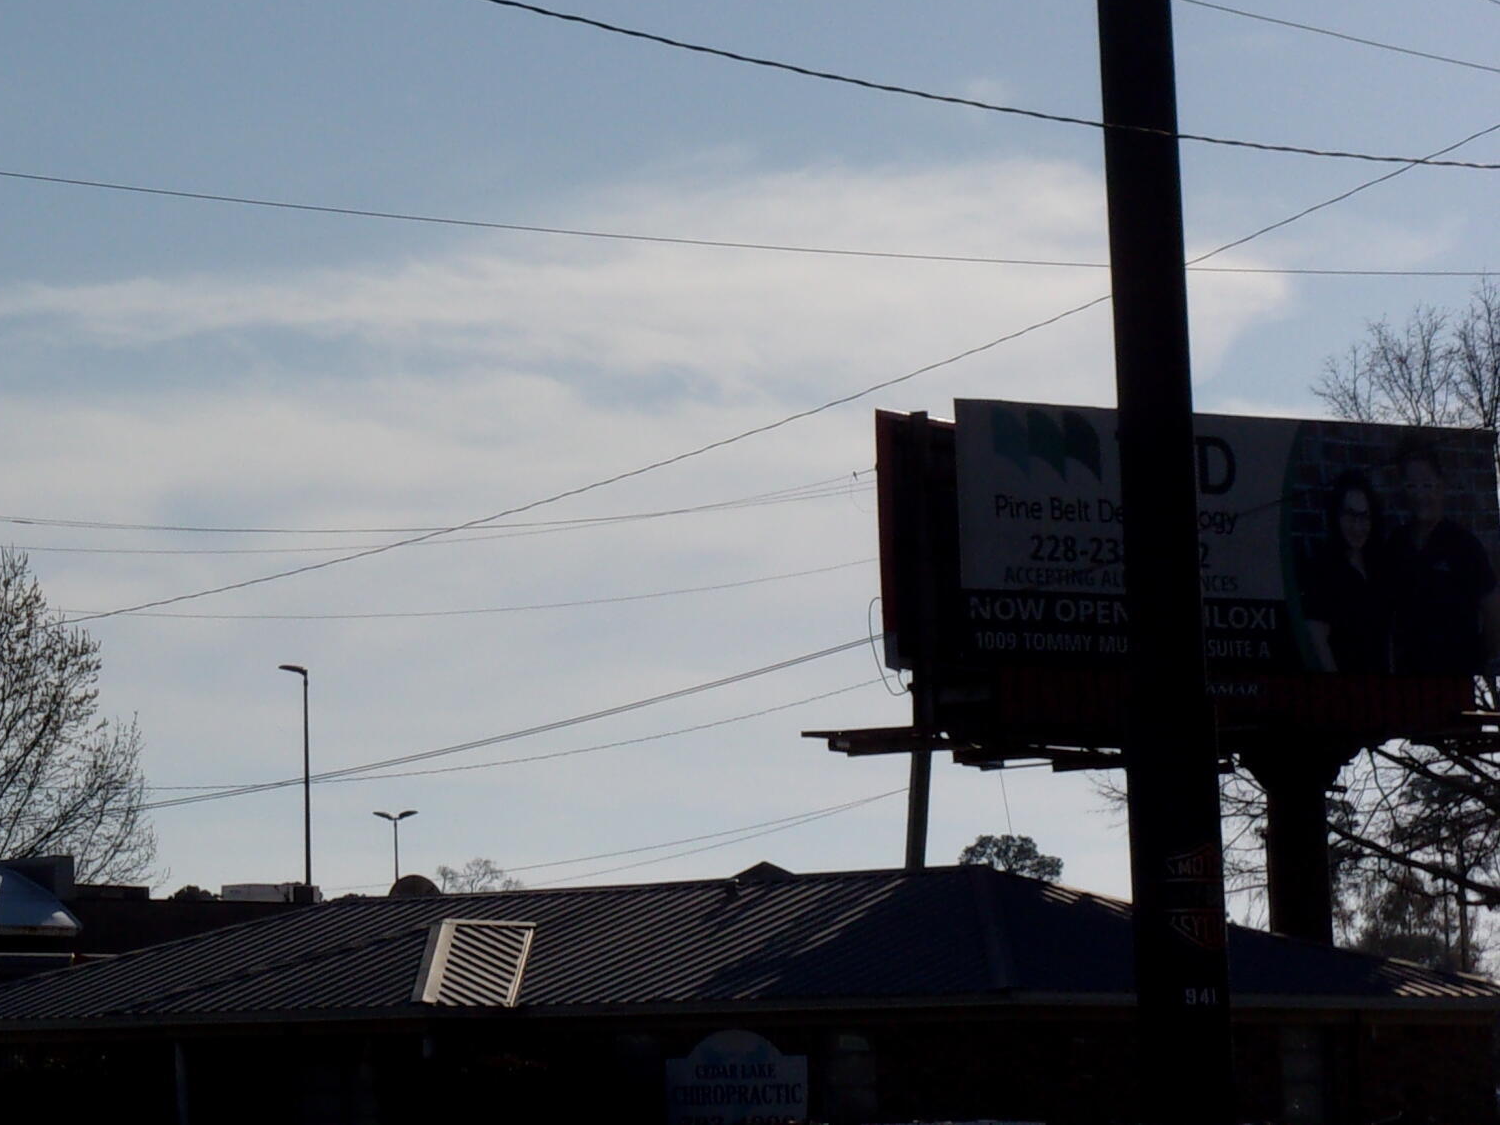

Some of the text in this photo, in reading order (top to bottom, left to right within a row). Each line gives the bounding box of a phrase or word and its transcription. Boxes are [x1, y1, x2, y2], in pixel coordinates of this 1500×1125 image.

[994, 494, 1043, 520] Pine
[1050, 496, 1091, 523] Belt
[1003, 565, 1095, 587] ACCEPTING
[968, 595, 1277, 631] NOW OPEN ILOXI
[974, 630, 1017, 651] 1009
[1023, 631, 1092, 652] TOMMY
[1206, 638, 1255, 659] SUITE
[741, 1063, 776, 1079] LAKE
[674, 1083, 804, 1106] CHIROPRACTIC
